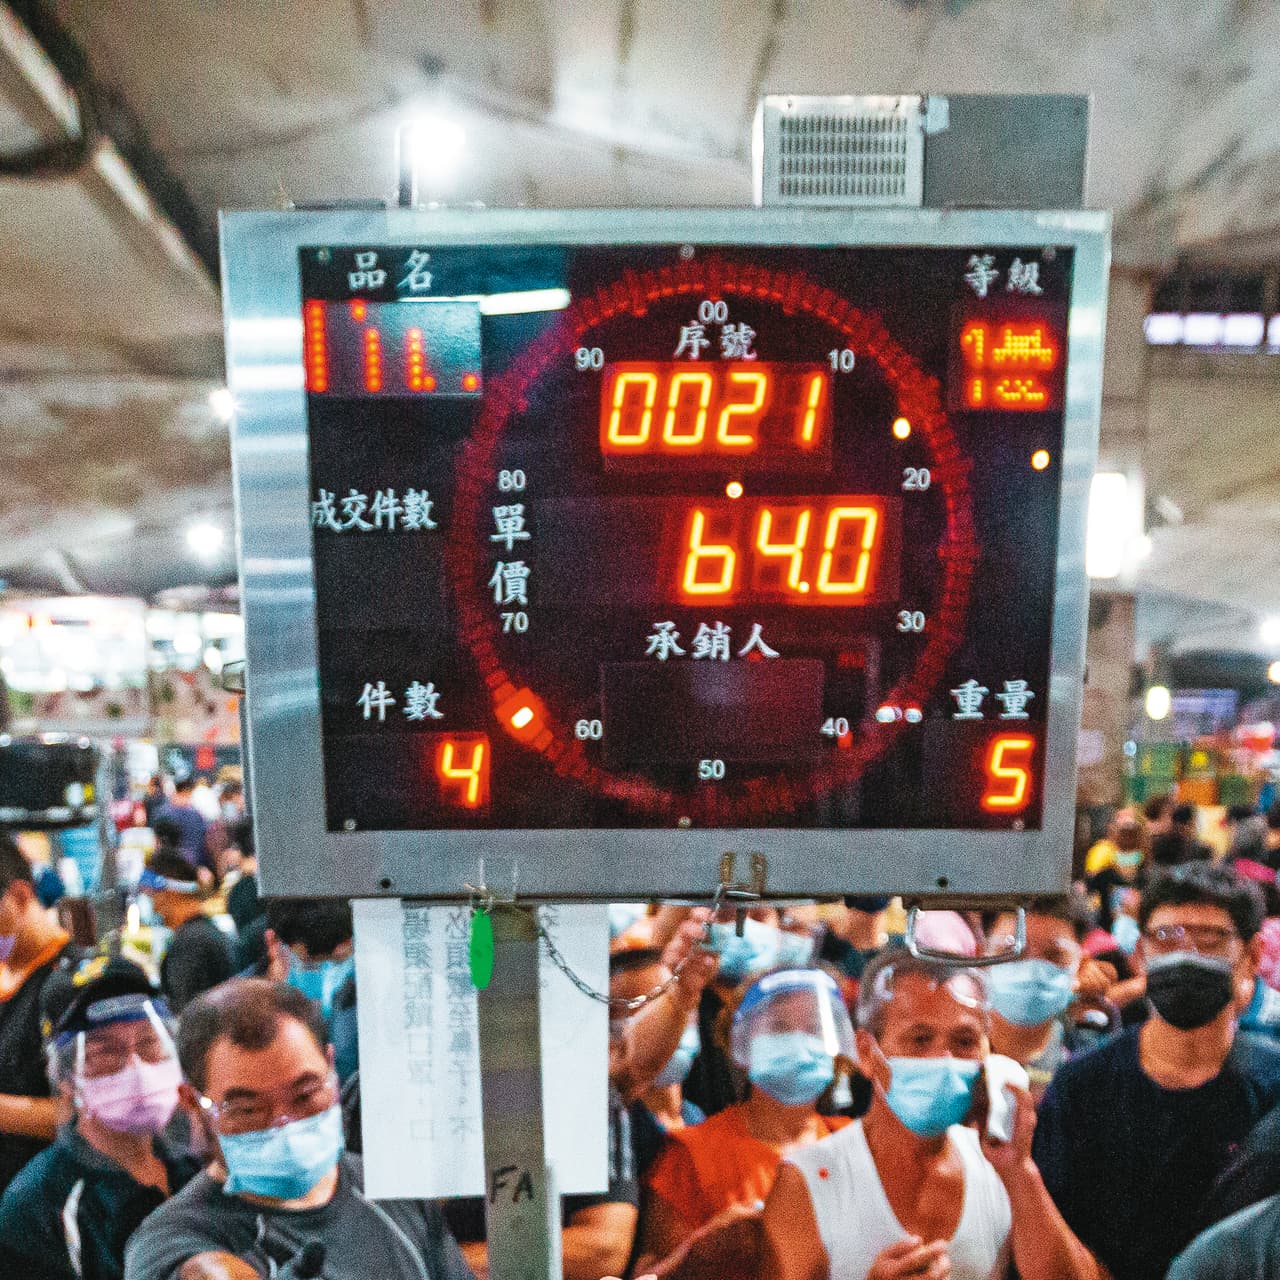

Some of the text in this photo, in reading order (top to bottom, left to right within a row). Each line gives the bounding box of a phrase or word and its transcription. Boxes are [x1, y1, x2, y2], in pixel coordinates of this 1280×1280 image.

[348, 249, 434, 291] 品名
[964, 254, 1044, 297] 等級
[698, 300, 728, 324] 00
[574, 346, 604, 371] 90
[674, 322, 757, 361] 序號
[828, 348, 855, 373] 10
[607, 371, 823, 446] 0021
[498, 469, 526, 492] 80
[902, 467, 931, 491] 20
[311, 487, 439, 532] 成交件數
[487, 502, 532, 606] 單價
[500, 611, 529, 634] 70
[897, 610, 926, 632] 30
[645, 621, 780, 662] 承銷人
[357, 680, 444, 721] 件數
[950, 678, 1035, 721] 重量
[575, 718, 603, 740] 60
[820, 717, 850, 737] 40
[441, 742, 485, 804] 4
[698, 759, 726, 780] 50
[986, 738, 1032, 807] 5
[489, 1164, 535, 1204] FA
